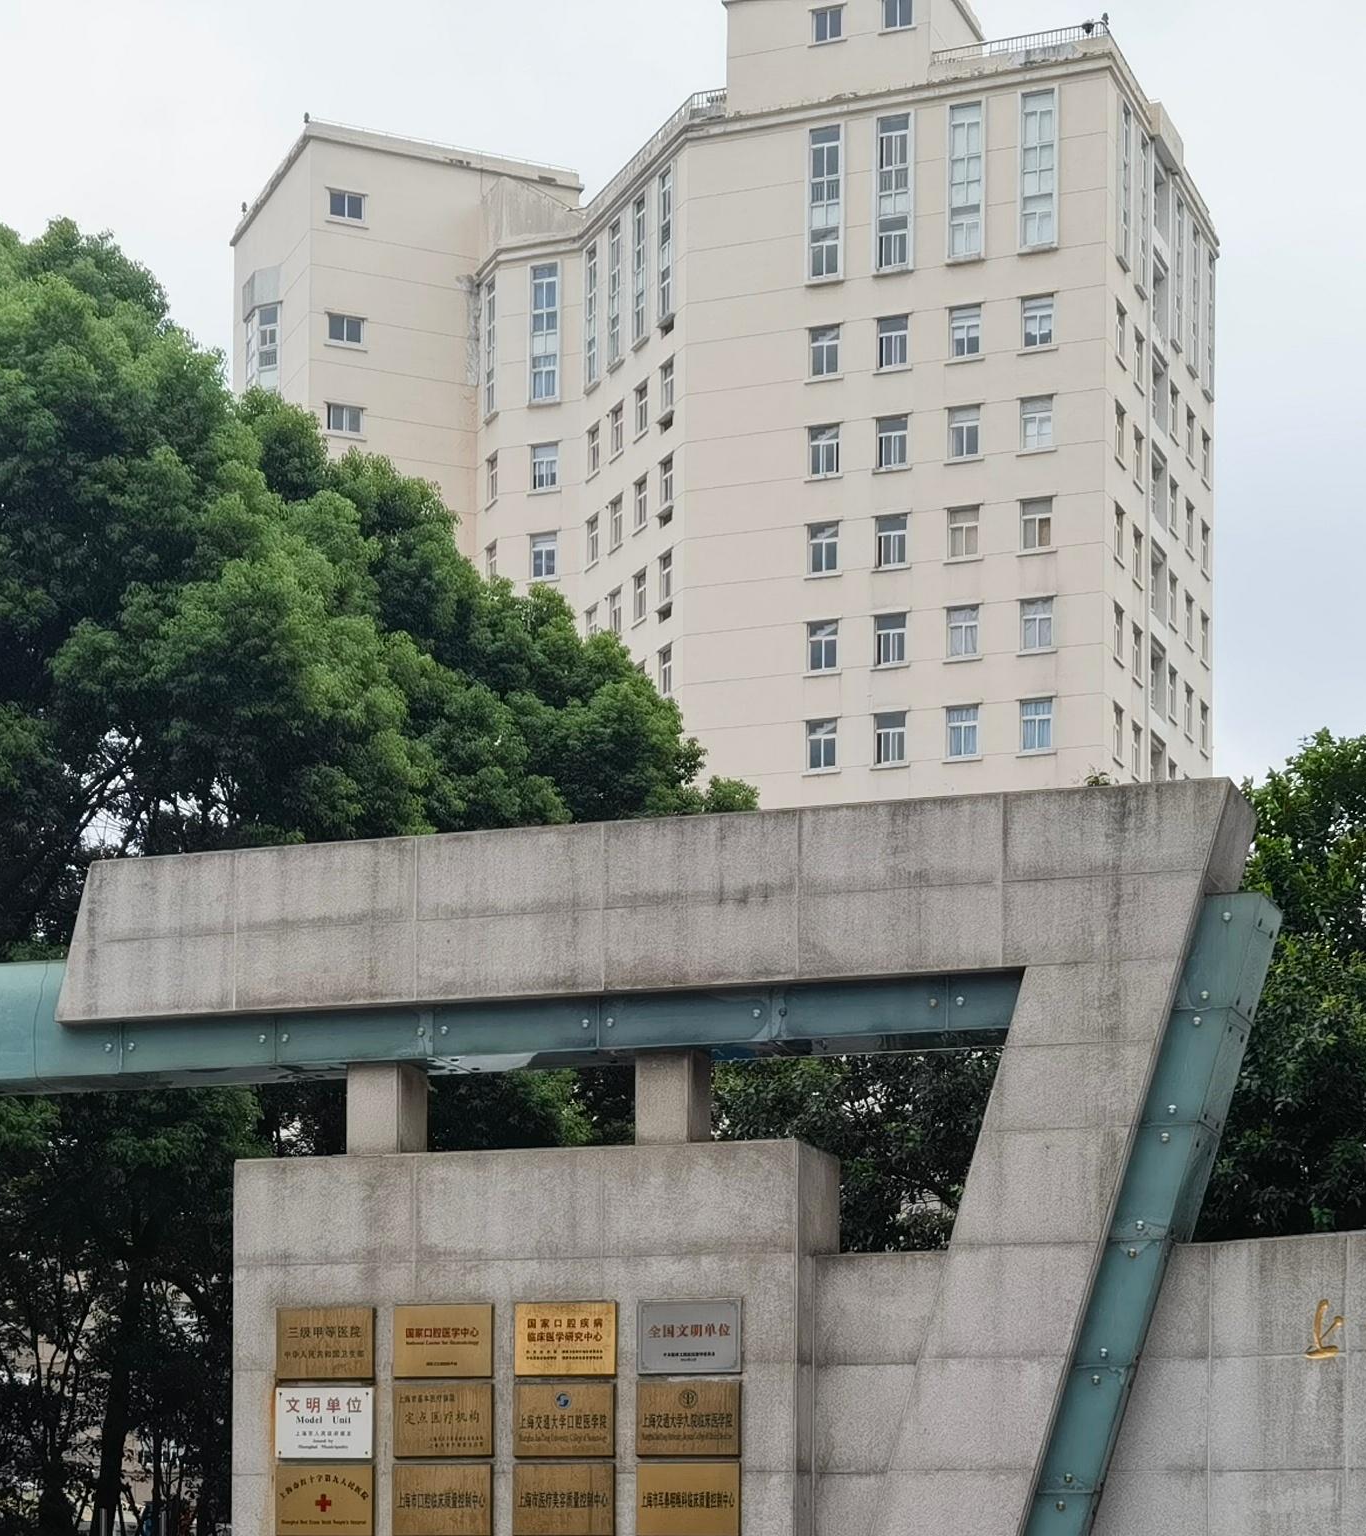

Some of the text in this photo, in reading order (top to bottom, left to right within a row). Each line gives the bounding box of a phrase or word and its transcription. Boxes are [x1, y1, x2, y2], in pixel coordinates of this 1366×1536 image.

[527, 1317, 604, 1329] 国家口腔疾病
[287, 1326, 363, 1340] 三级甲等医院
[405, 1326, 480, 1338] 国家口腔医学中心
[527, 1330, 604, 1343] 临床医学研究中心
[648, 1322, 732, 1339] 全国文明单位
[285, 1396, 363, 1414] 文明单位
[296, 1416, 351, 1424] Model Unit
